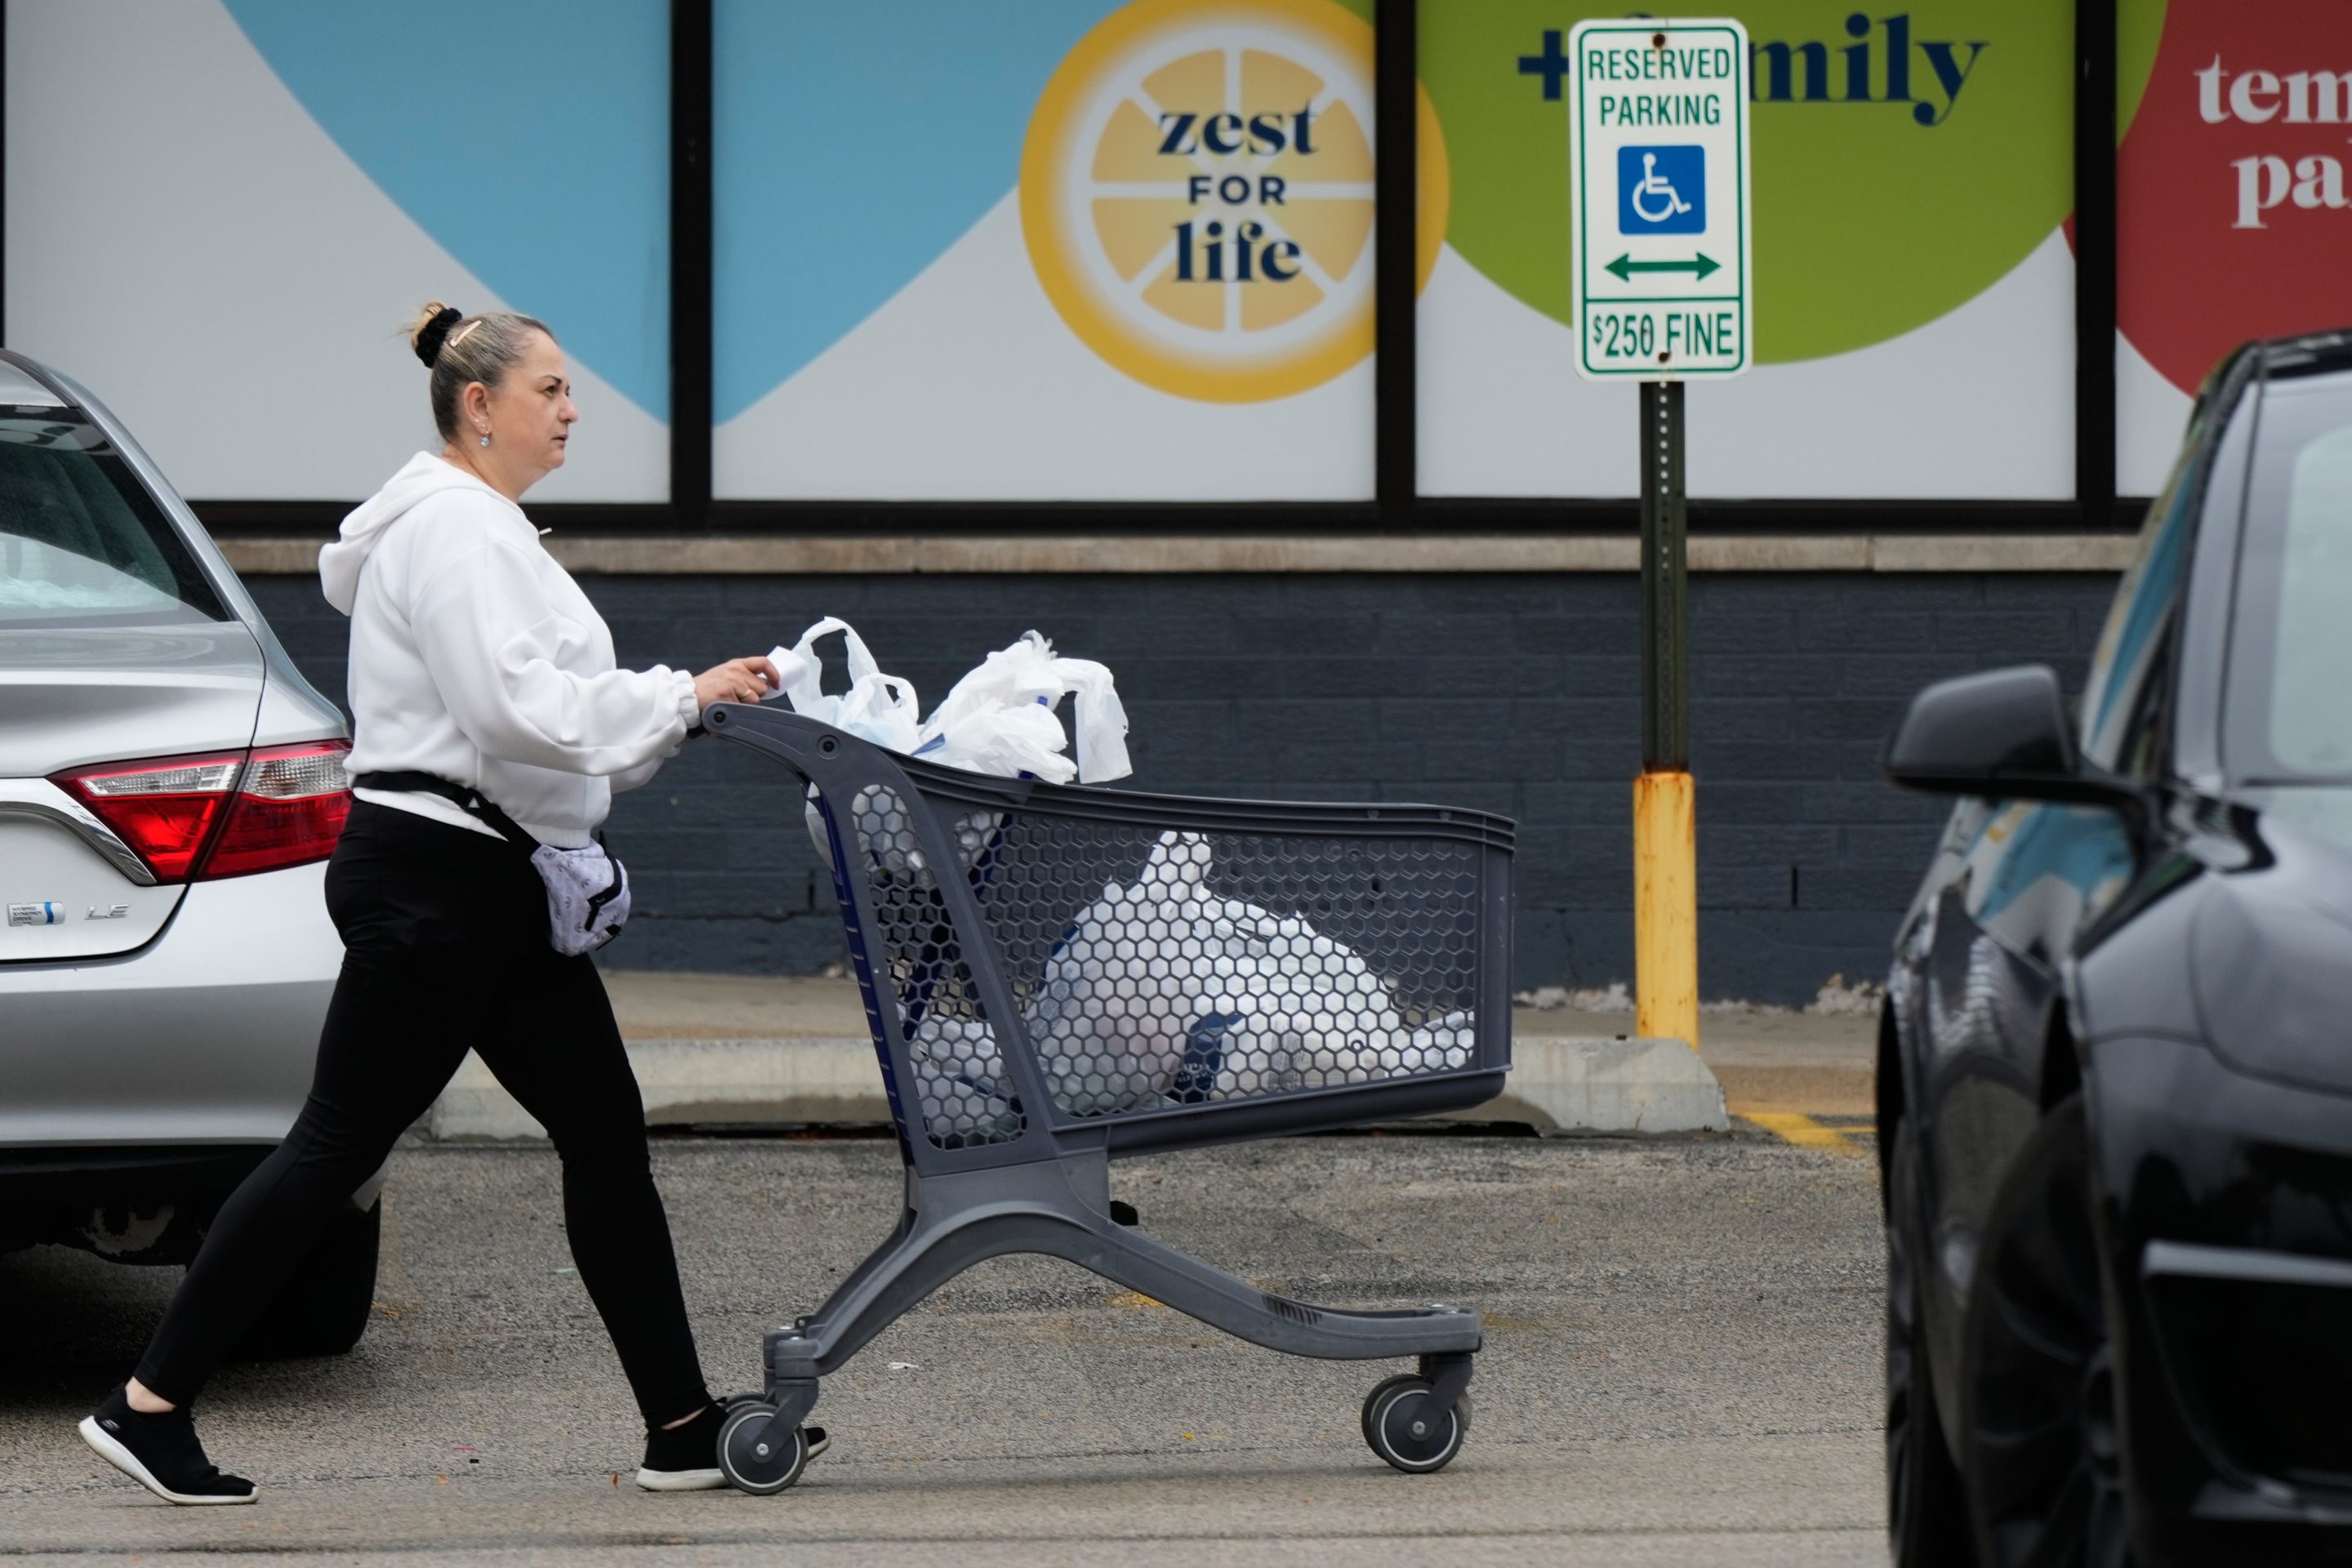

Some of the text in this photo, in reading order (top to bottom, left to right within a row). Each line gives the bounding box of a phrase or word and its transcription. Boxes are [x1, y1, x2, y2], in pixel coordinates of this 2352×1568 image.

[1588, 48, 1730, 80] RESERVED
[1624, 13, 1990, 127] mily
[1157, 98, 1320, 155] zest
[1600, 94, 1721, 126] PARKING
[1188, 175, 1285, 206] FOR
[2230, 154, 2352, 229] pa
[1171, 220, 1302, 283] life
[1592, 313, 1734, 358] $250 FINE
[85, 904, 131, 920] LE
